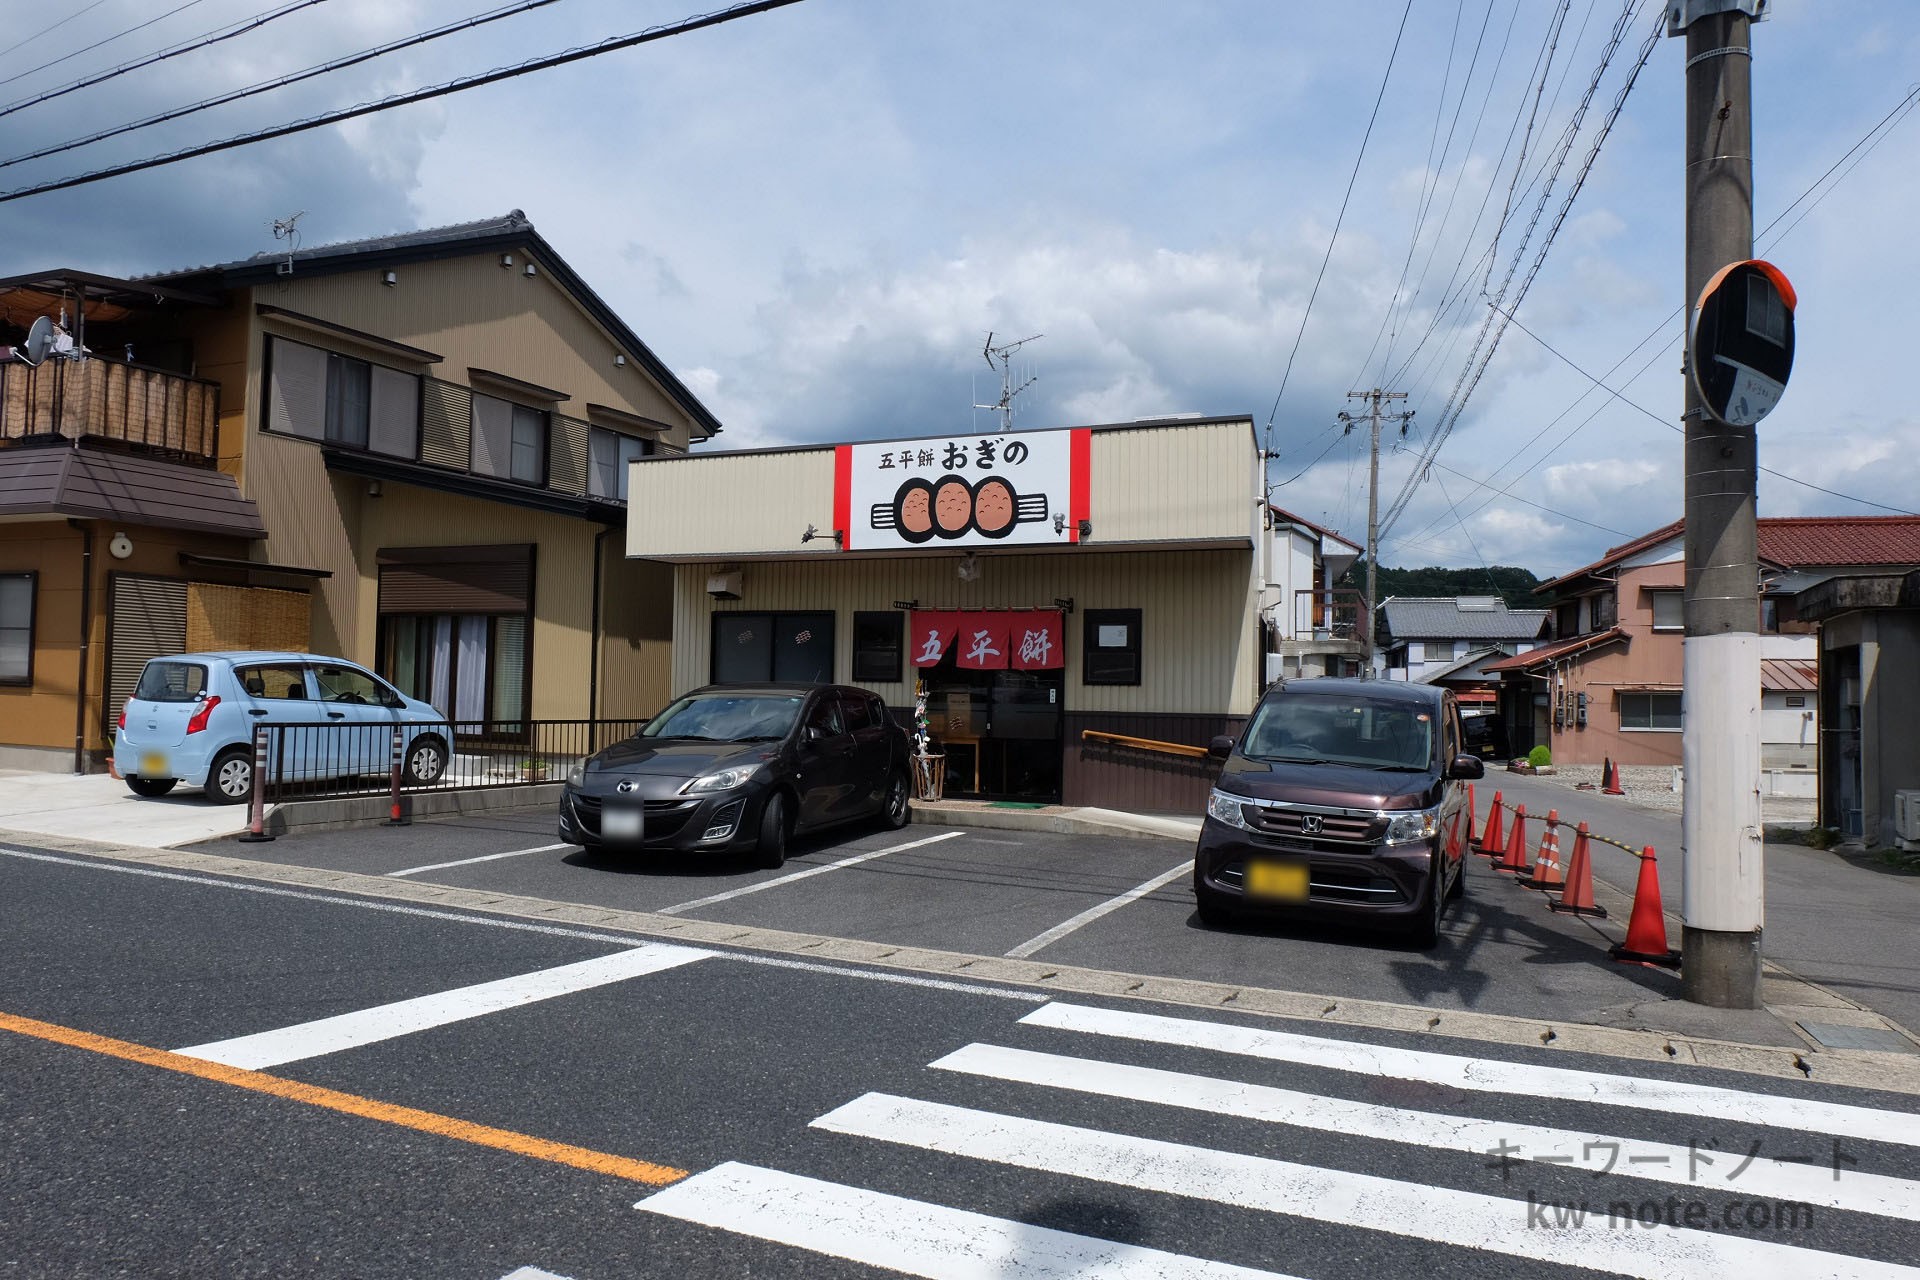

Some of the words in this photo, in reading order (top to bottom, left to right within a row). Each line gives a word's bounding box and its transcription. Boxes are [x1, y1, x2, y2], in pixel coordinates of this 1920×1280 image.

[878, 448, 935, 470] 五平餅
[941, 437, 1029, 470] おぎの
[915, 629, 1053, 666] 五平餅
